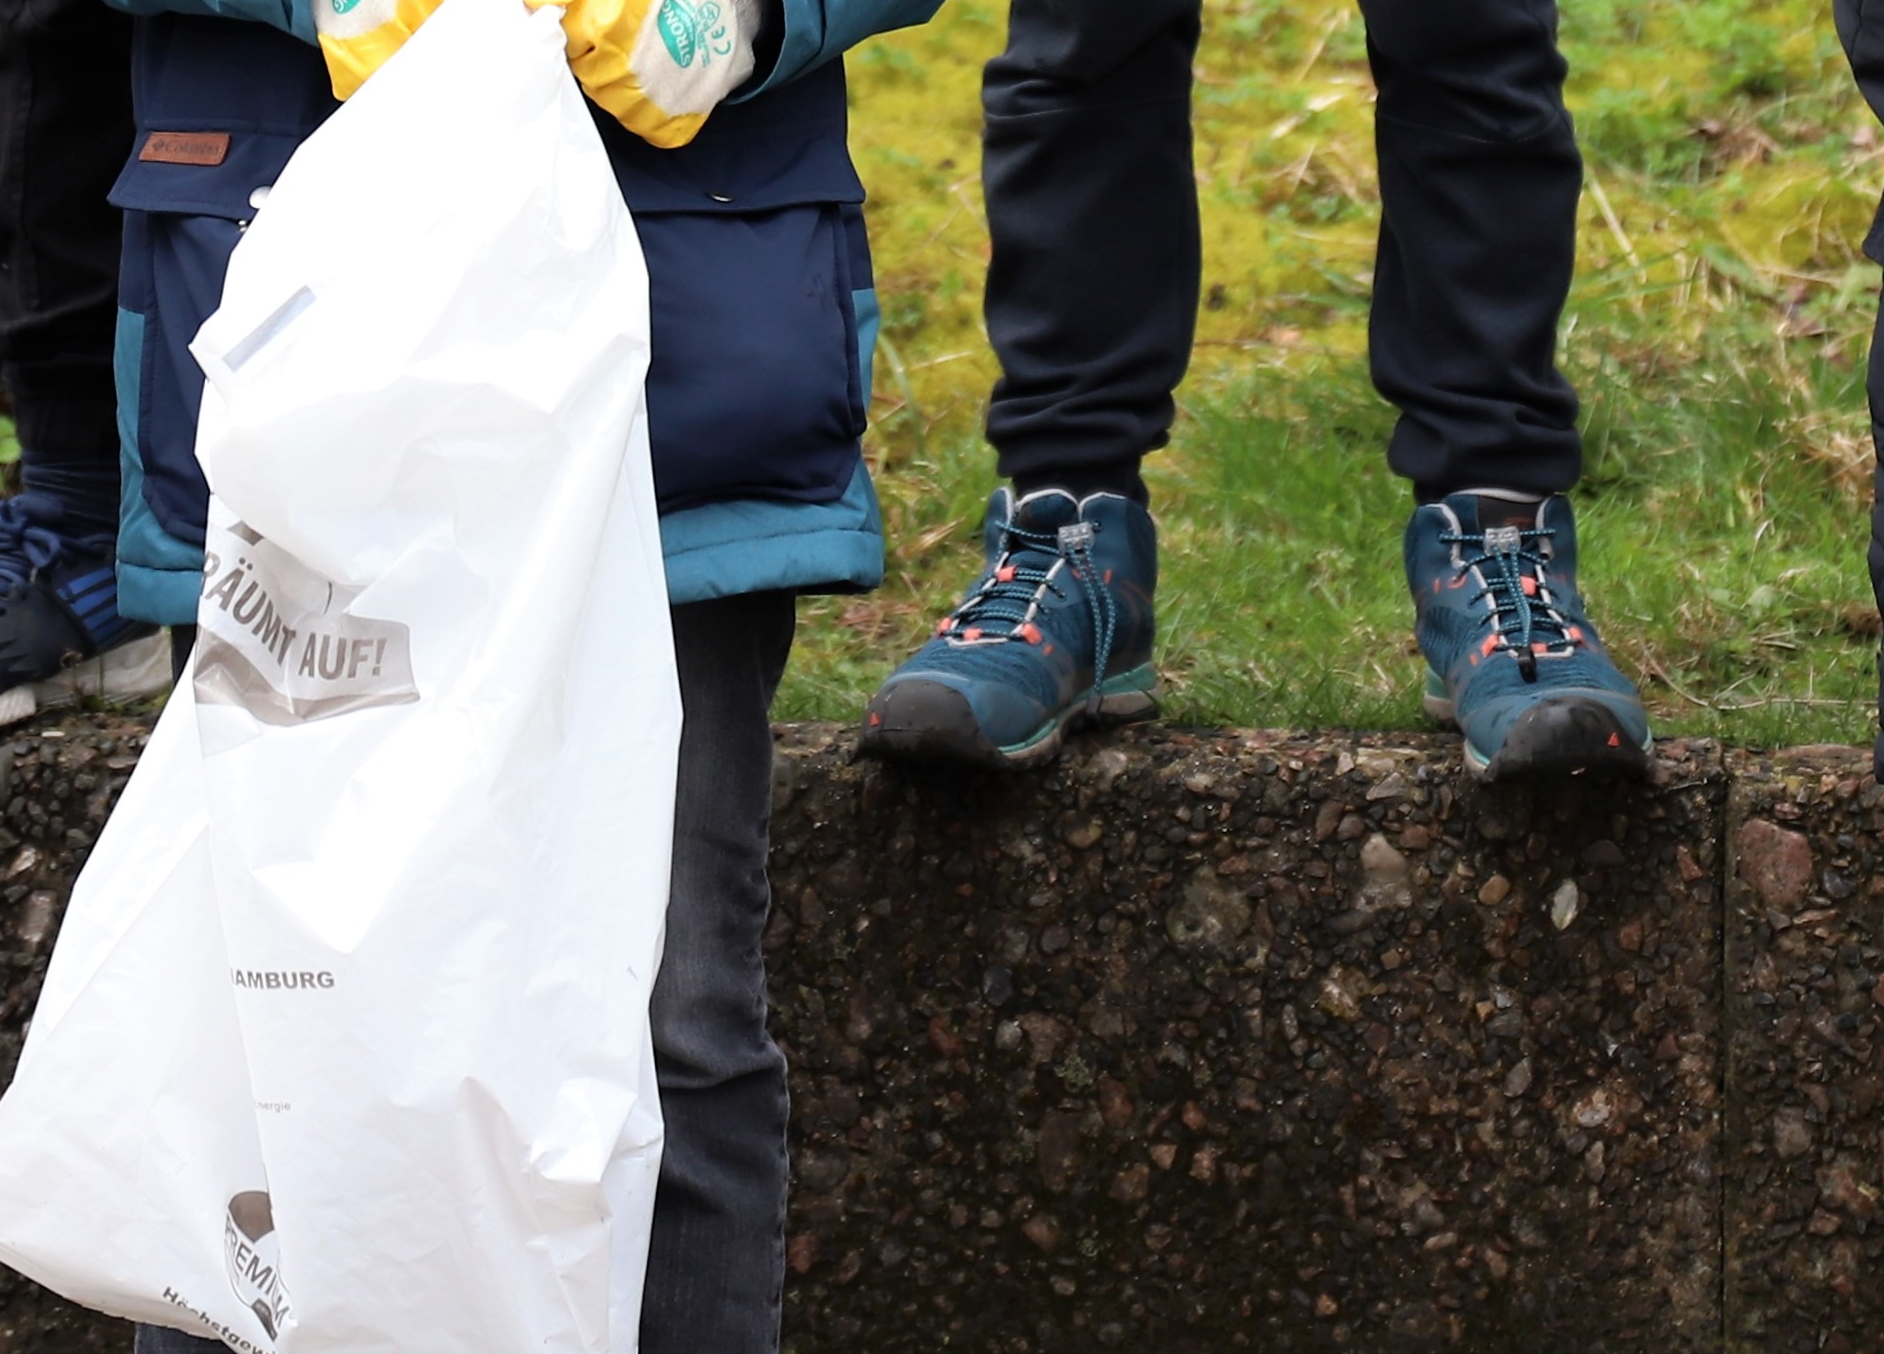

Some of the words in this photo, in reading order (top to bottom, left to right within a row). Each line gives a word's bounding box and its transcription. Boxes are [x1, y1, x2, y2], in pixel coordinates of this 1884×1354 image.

[662, 1, 691, 64] STRONG
[299, 631, 387, 680] AUF!
[230, 967, 334, 990] AMBURG
